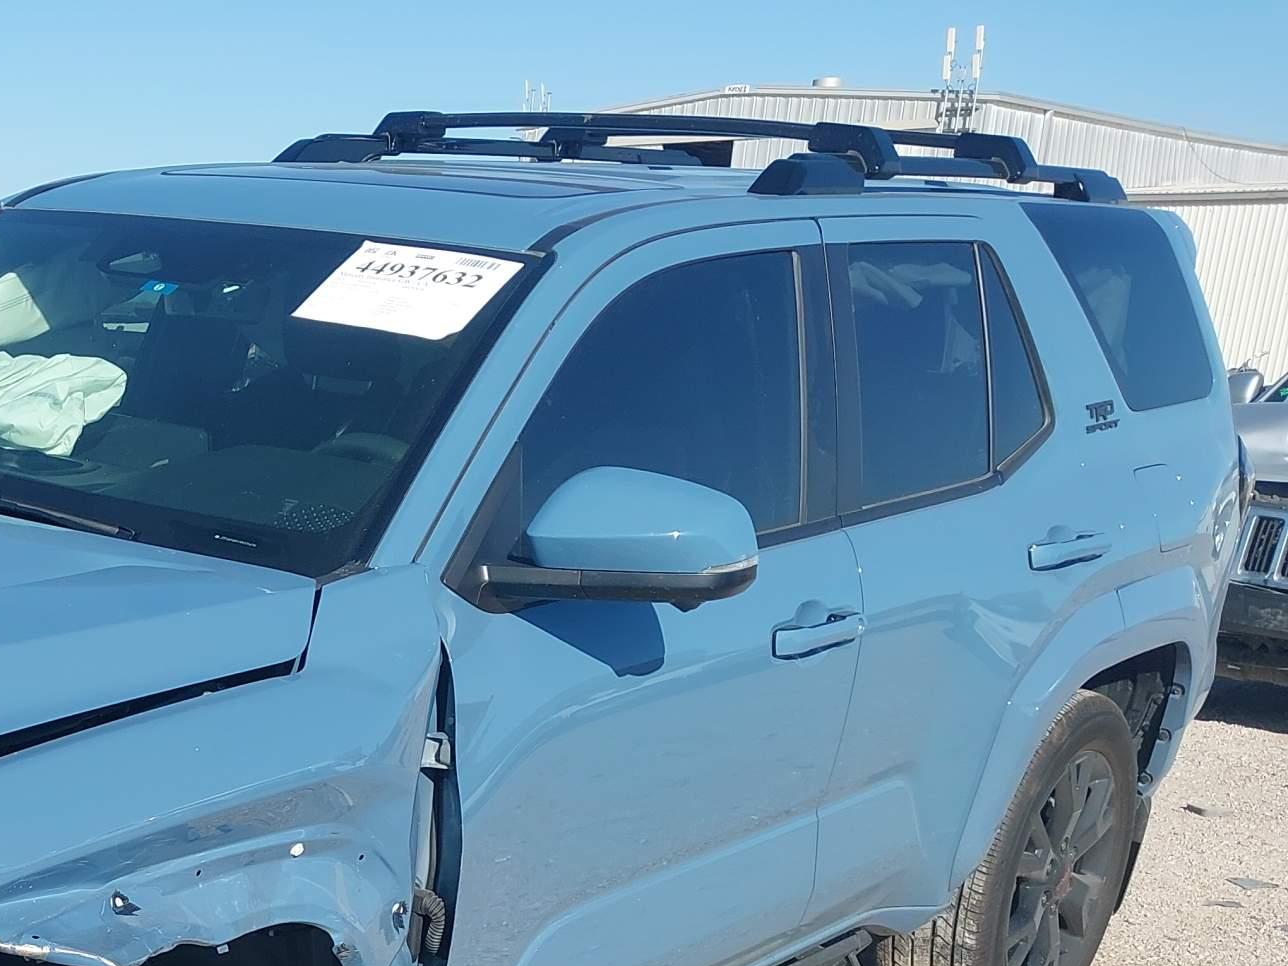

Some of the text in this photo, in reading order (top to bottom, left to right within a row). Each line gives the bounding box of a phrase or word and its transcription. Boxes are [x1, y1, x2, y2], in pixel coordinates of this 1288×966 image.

[355, 260, 483, 288] 44937632
[1086, 400, 1114, 422] TRD
[1086, 419, 1120, 434] SPORT
